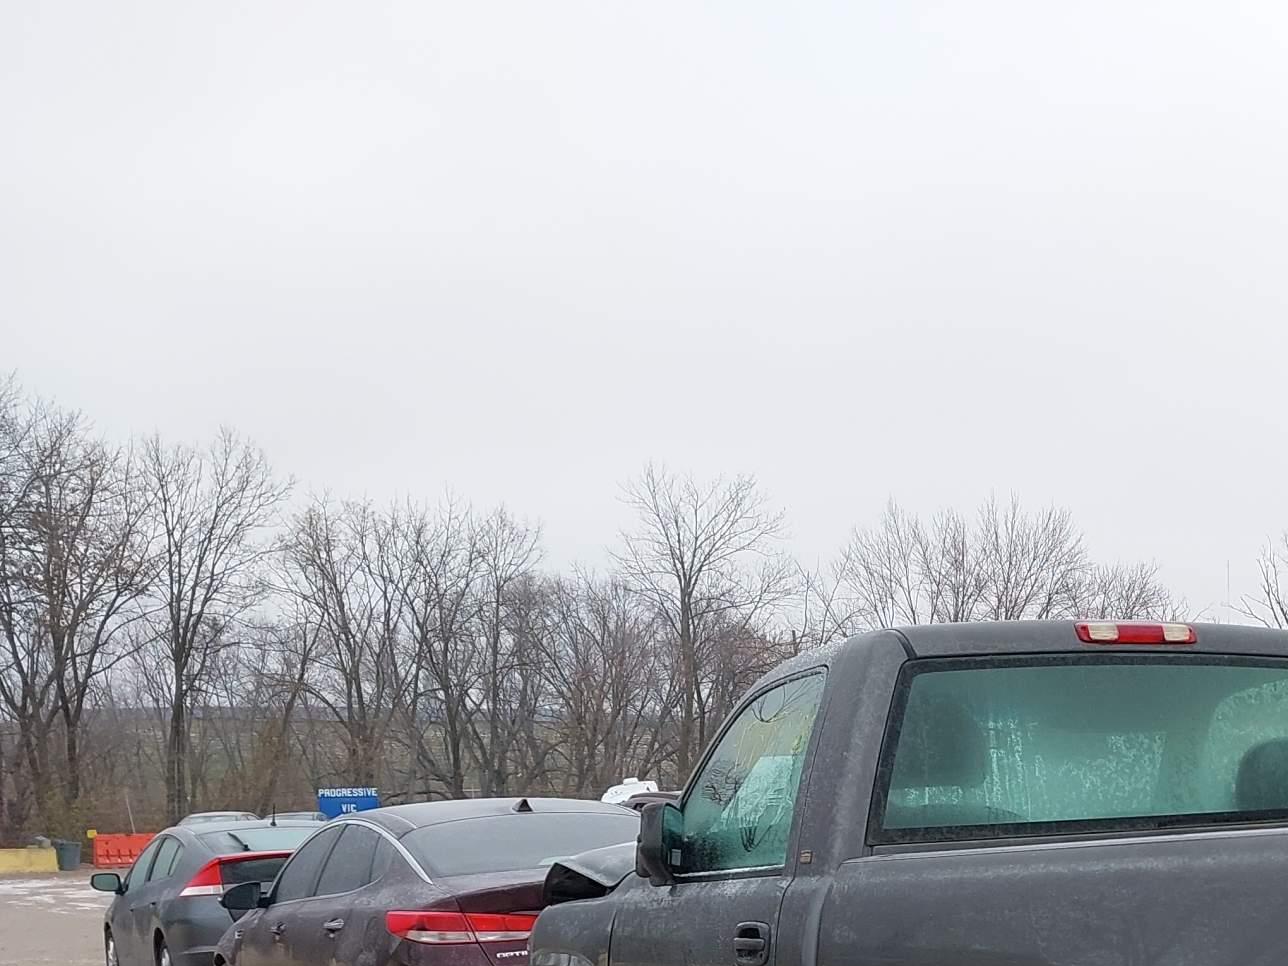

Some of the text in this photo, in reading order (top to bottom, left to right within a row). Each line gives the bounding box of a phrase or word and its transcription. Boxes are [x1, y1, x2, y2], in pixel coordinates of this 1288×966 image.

[318, 787, 378, 797] PROGRESSIVE
[341, 803, 357, 813] VIC
[496, 950, 528, 958] OPTI
